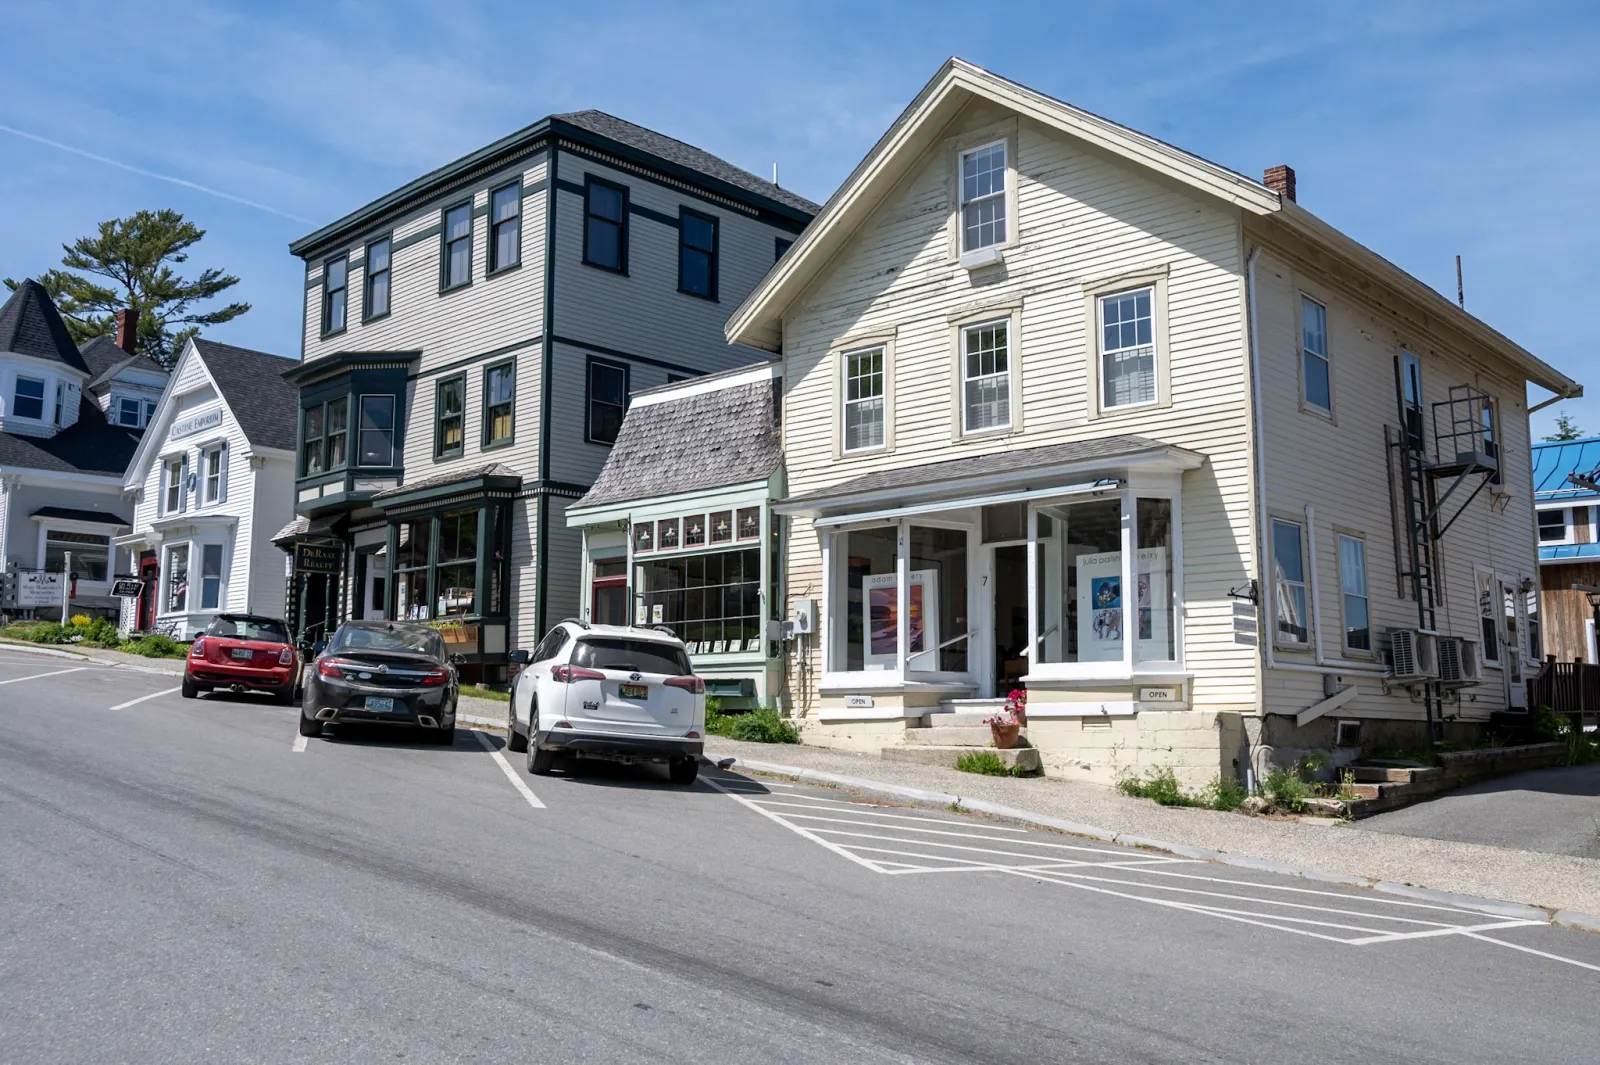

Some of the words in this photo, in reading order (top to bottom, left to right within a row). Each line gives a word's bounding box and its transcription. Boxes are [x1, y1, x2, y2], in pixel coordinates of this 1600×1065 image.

[194, 412, 219, 429] EMPORIUM
[303, 558, 334, 569] REALTY
[1083, 557, 1097, 567] julia
[871, 575, 893, 584] adam
[982, 575, 988, 587] 7
